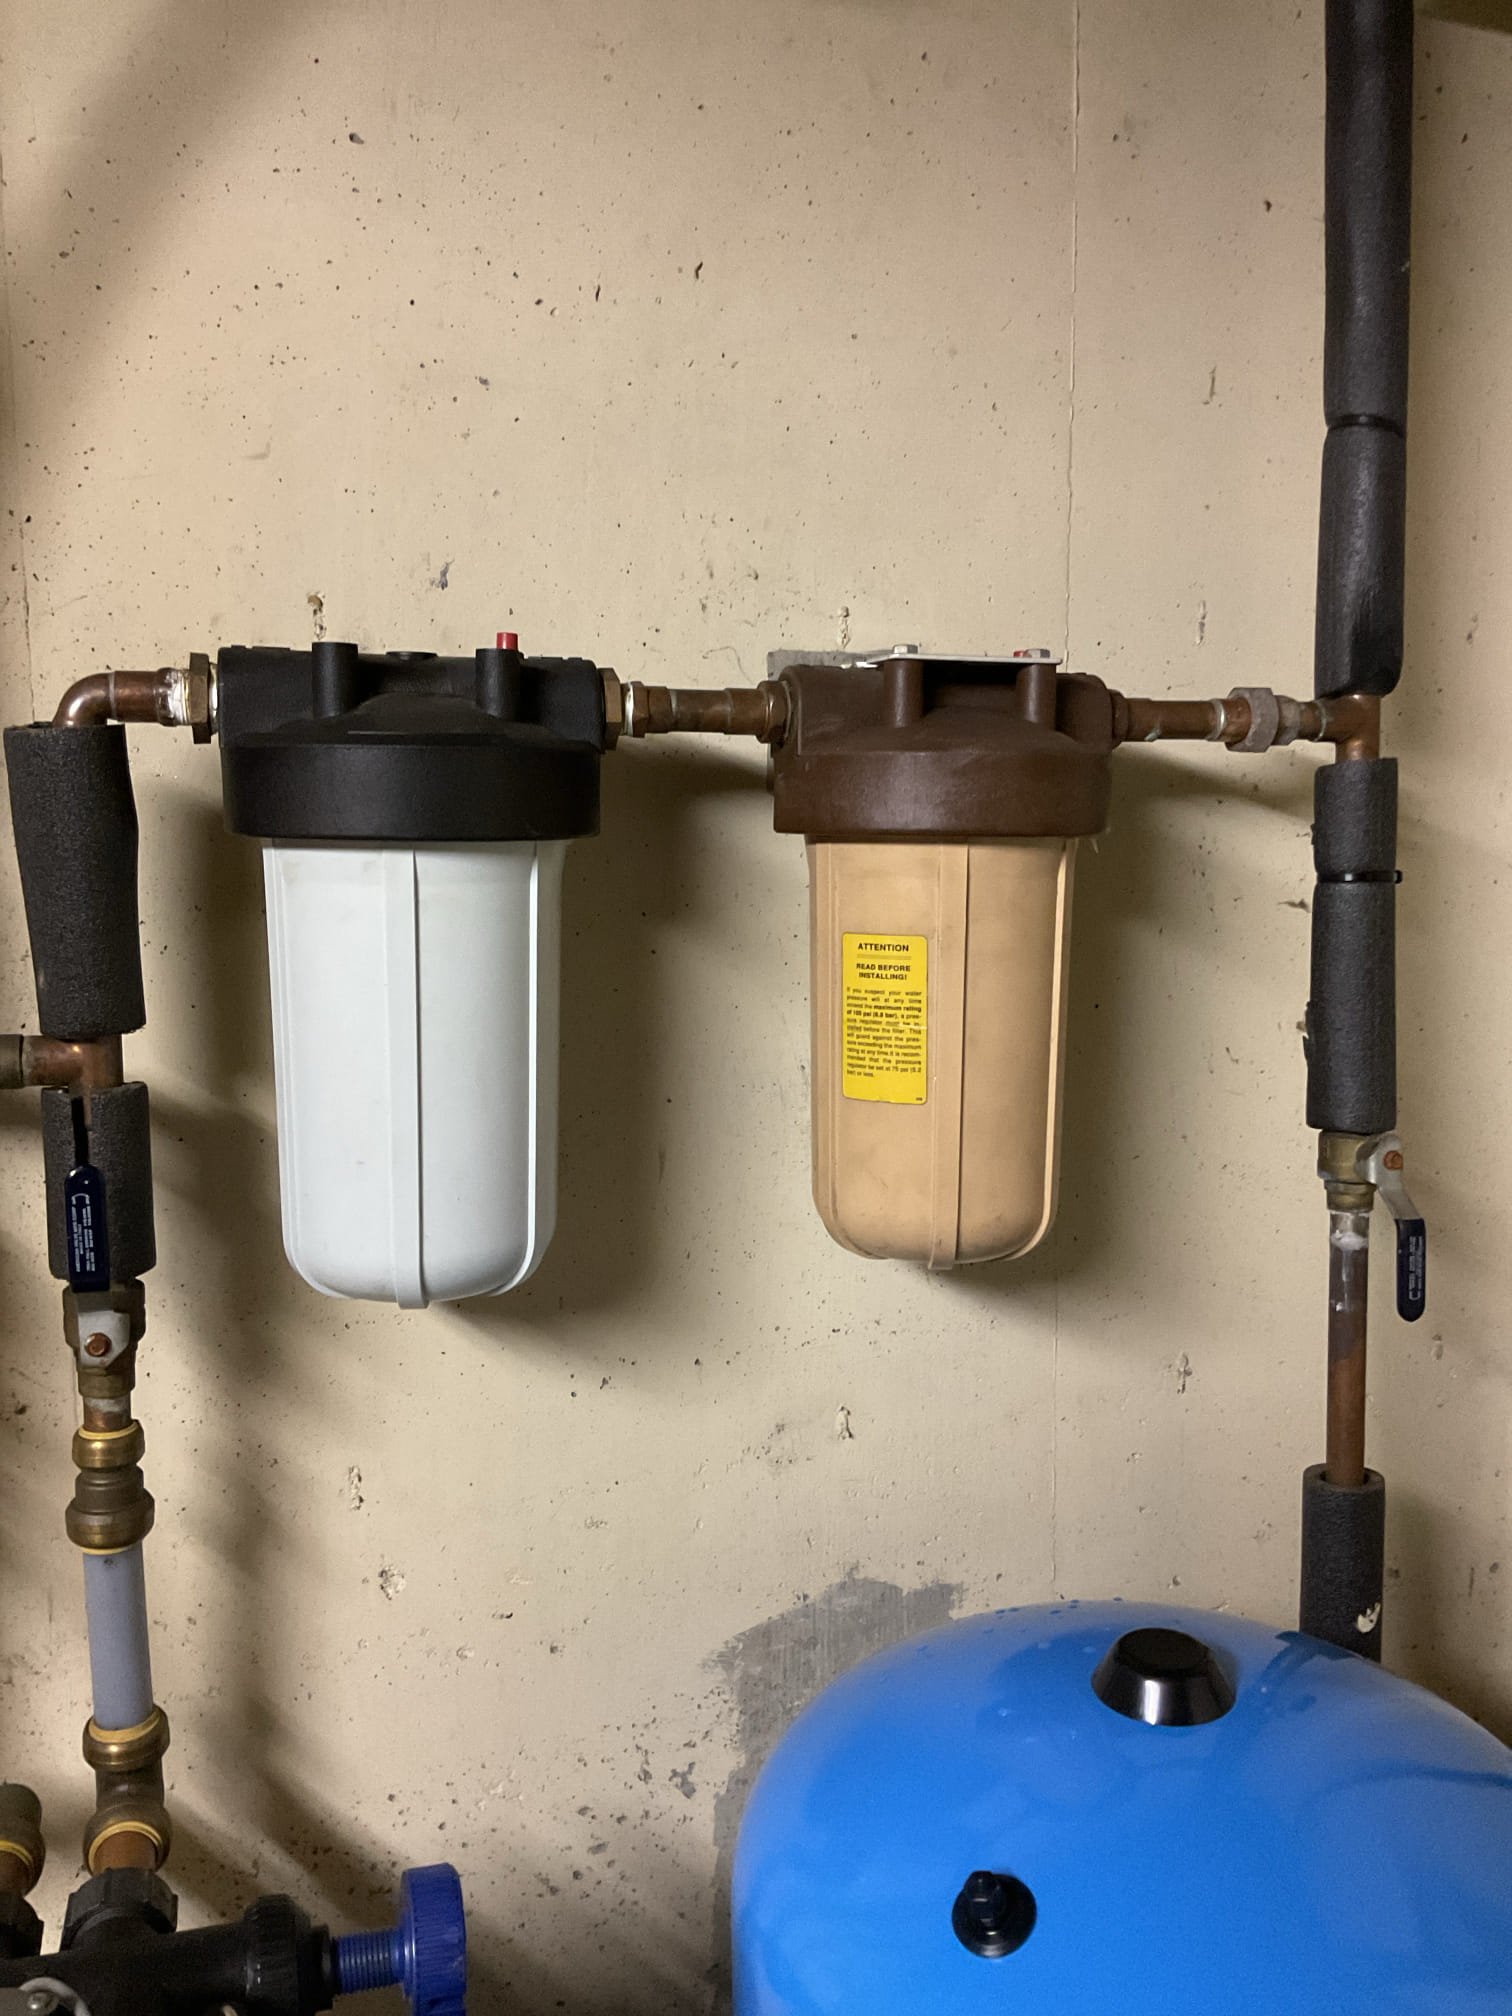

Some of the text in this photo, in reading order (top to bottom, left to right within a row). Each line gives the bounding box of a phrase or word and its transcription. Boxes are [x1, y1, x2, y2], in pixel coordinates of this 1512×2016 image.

[858, 942, 909, 952] ATTENTION
[878, 964, 911, 972] BEFORE
[859, 972, 907, 980] INSTALLING!
